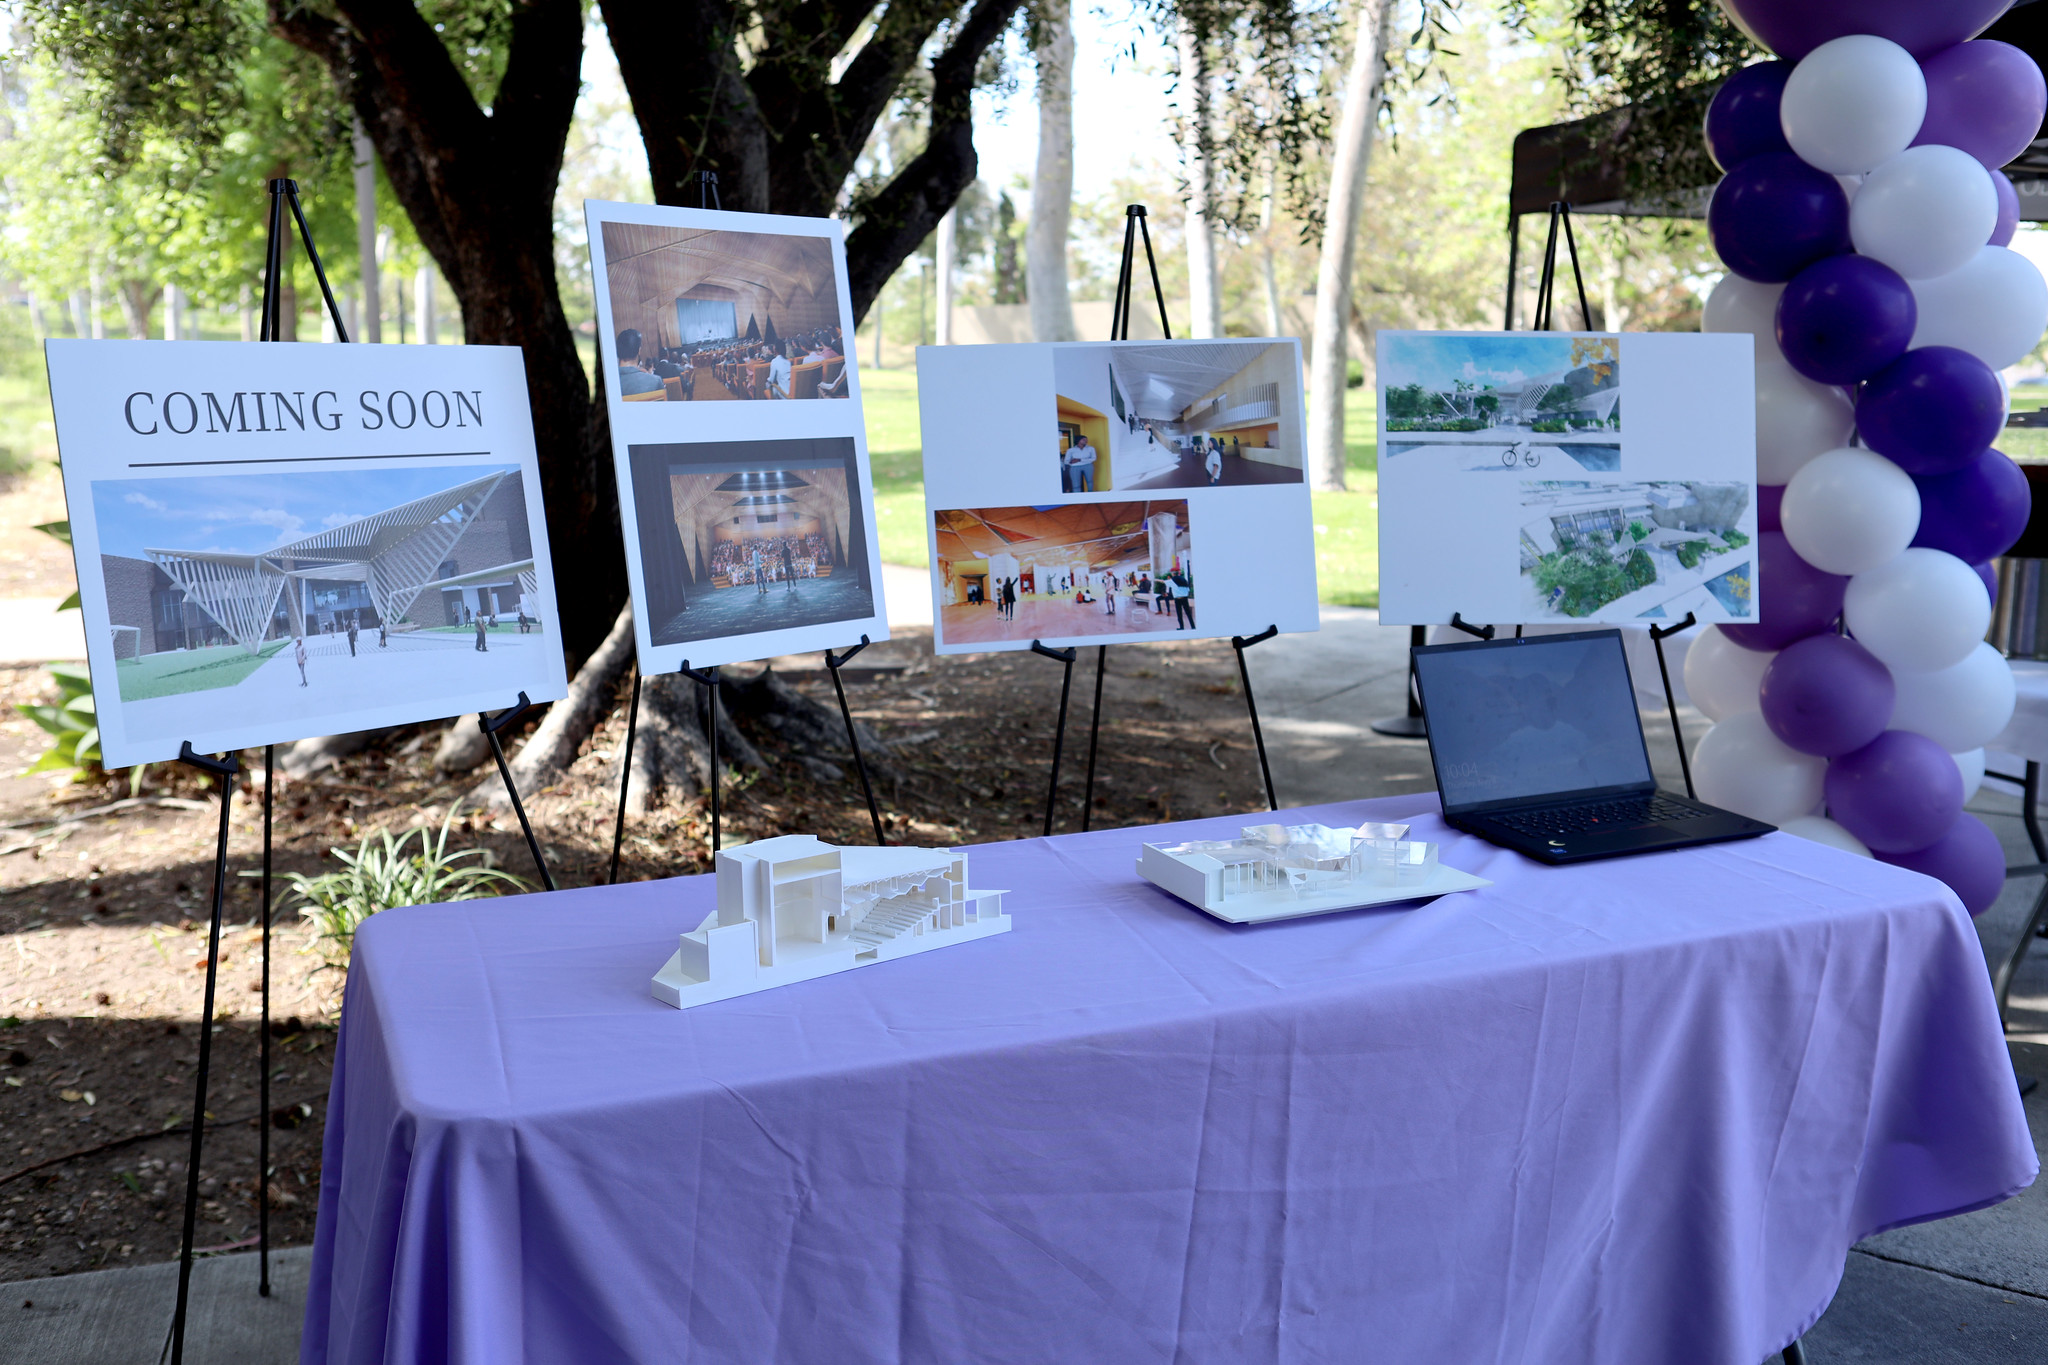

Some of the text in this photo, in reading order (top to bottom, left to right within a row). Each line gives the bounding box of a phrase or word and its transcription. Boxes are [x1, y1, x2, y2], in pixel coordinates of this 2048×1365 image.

[124, 390, 483, 435] COMING SOON
[1444, 761, 1479, 780] 10:04
